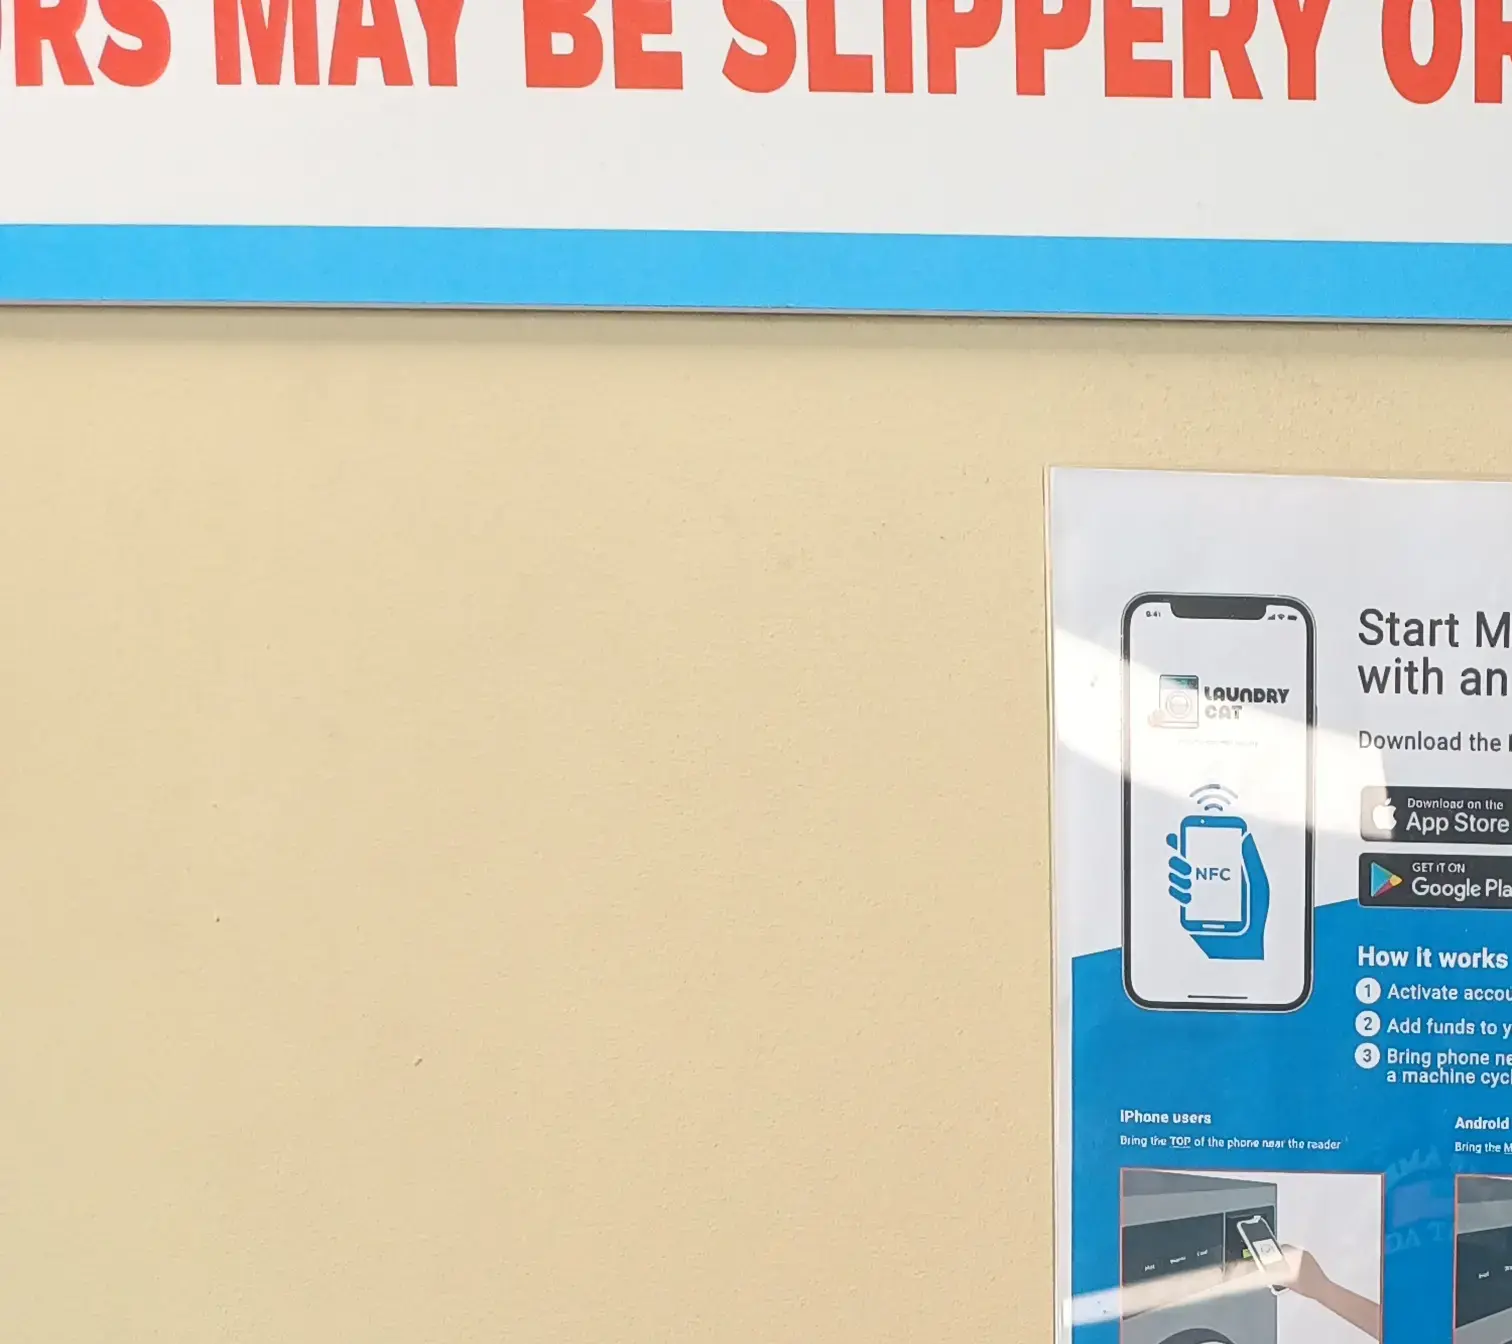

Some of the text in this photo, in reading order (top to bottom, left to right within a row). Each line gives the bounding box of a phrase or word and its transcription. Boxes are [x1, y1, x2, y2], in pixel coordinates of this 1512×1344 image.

[0, 0, 172, 89] RS
[213, 0, 467, 87] MAY
[523, 0, 684, 91] BE
[721, 0, 1331, 102] SLIPPERY
[1358, 608, 1459, 647] Start
[1358, 656, 1443, 694] with
[1460, 667, 1507, 696] an
[1204, 686, 1290, 704] LAUNDRY
[1358, 730, 1461, 751] Download
[1469, 733, 1501, 752] the
[1407, 798, 1504, 810] Download on the
[1405, 812, 1510, 836] App Store
[1195, 867, 1231, 881] NFC
[1412, 862, 1465, 874] GET IT ON
[1411, 877, 1481, 902] Google
[1358, 946, 1509, 969] How it works
[1387, 984, 1458, 1001] Activate
[1387, 1018, 1421, 1034] Add
[1426, 1019, 1475, 1035] funds
[1480, 1021, 1498, 1036] to
[1387, 1048, 1431, 1068] Bring
[1436, 1049, 1490, 1070] phone
[1386, 1072, 1397, 1084] a
[1402, 1069, 1476, 1085] machine
[1172, 1112, 1212, 1125] users
[1454, 1117, 1509, 1130] Android
[1120, 1135, 1341, 1150] Bring the TOP of the phone near the reader
[1454, 1142, 1482, 1154] Bring
[1484, 1142, 1501, 1153] the
